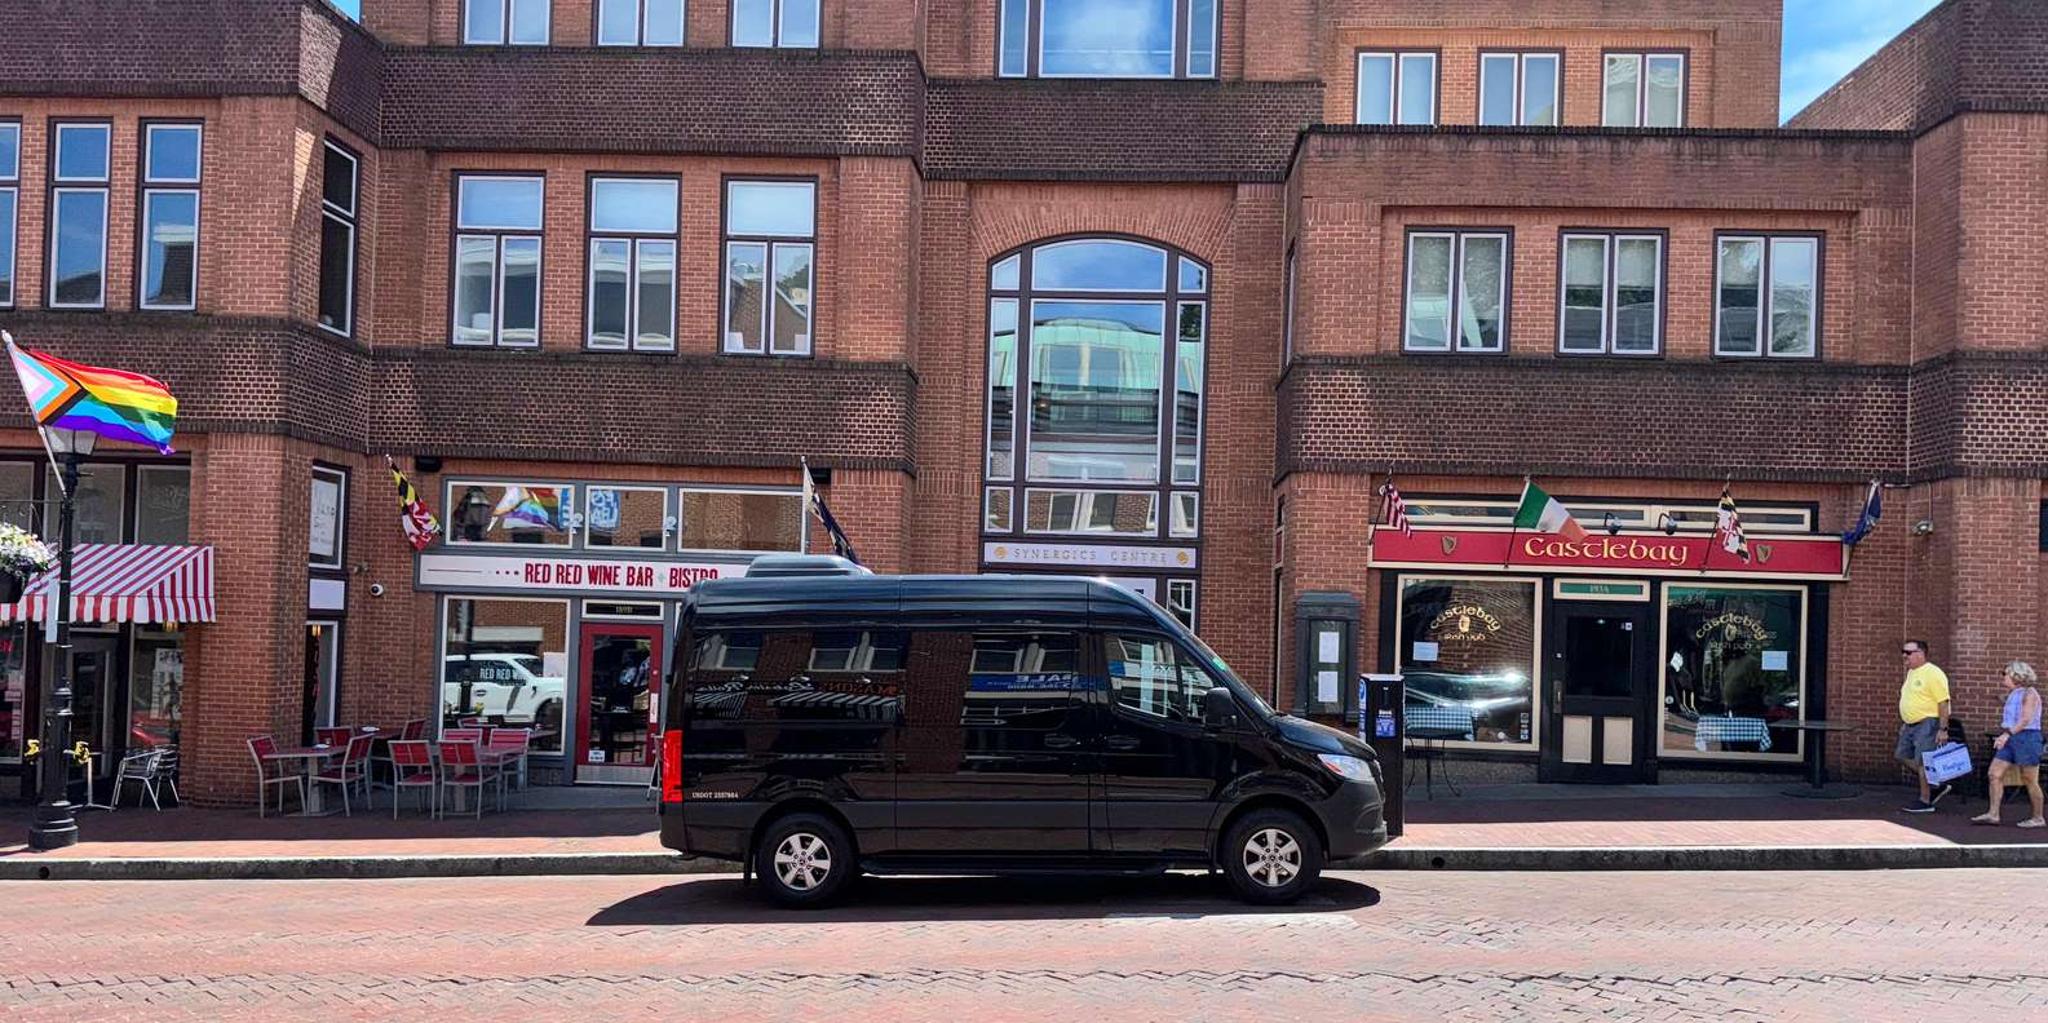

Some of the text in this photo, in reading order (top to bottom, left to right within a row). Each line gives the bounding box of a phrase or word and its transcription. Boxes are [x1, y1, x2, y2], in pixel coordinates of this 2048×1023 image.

[1013, 548, 1168, 563] SYNERGICS CENTRE
[1524, 537, 1688, 566] Castlebay
[525, 563, 550, 583] RED
[556, 564, 582, 585] RED
[587, 565, 621, 586] WINE
[626, 566, 654, 587] BAR
[480, 668, 494, 679] RED
